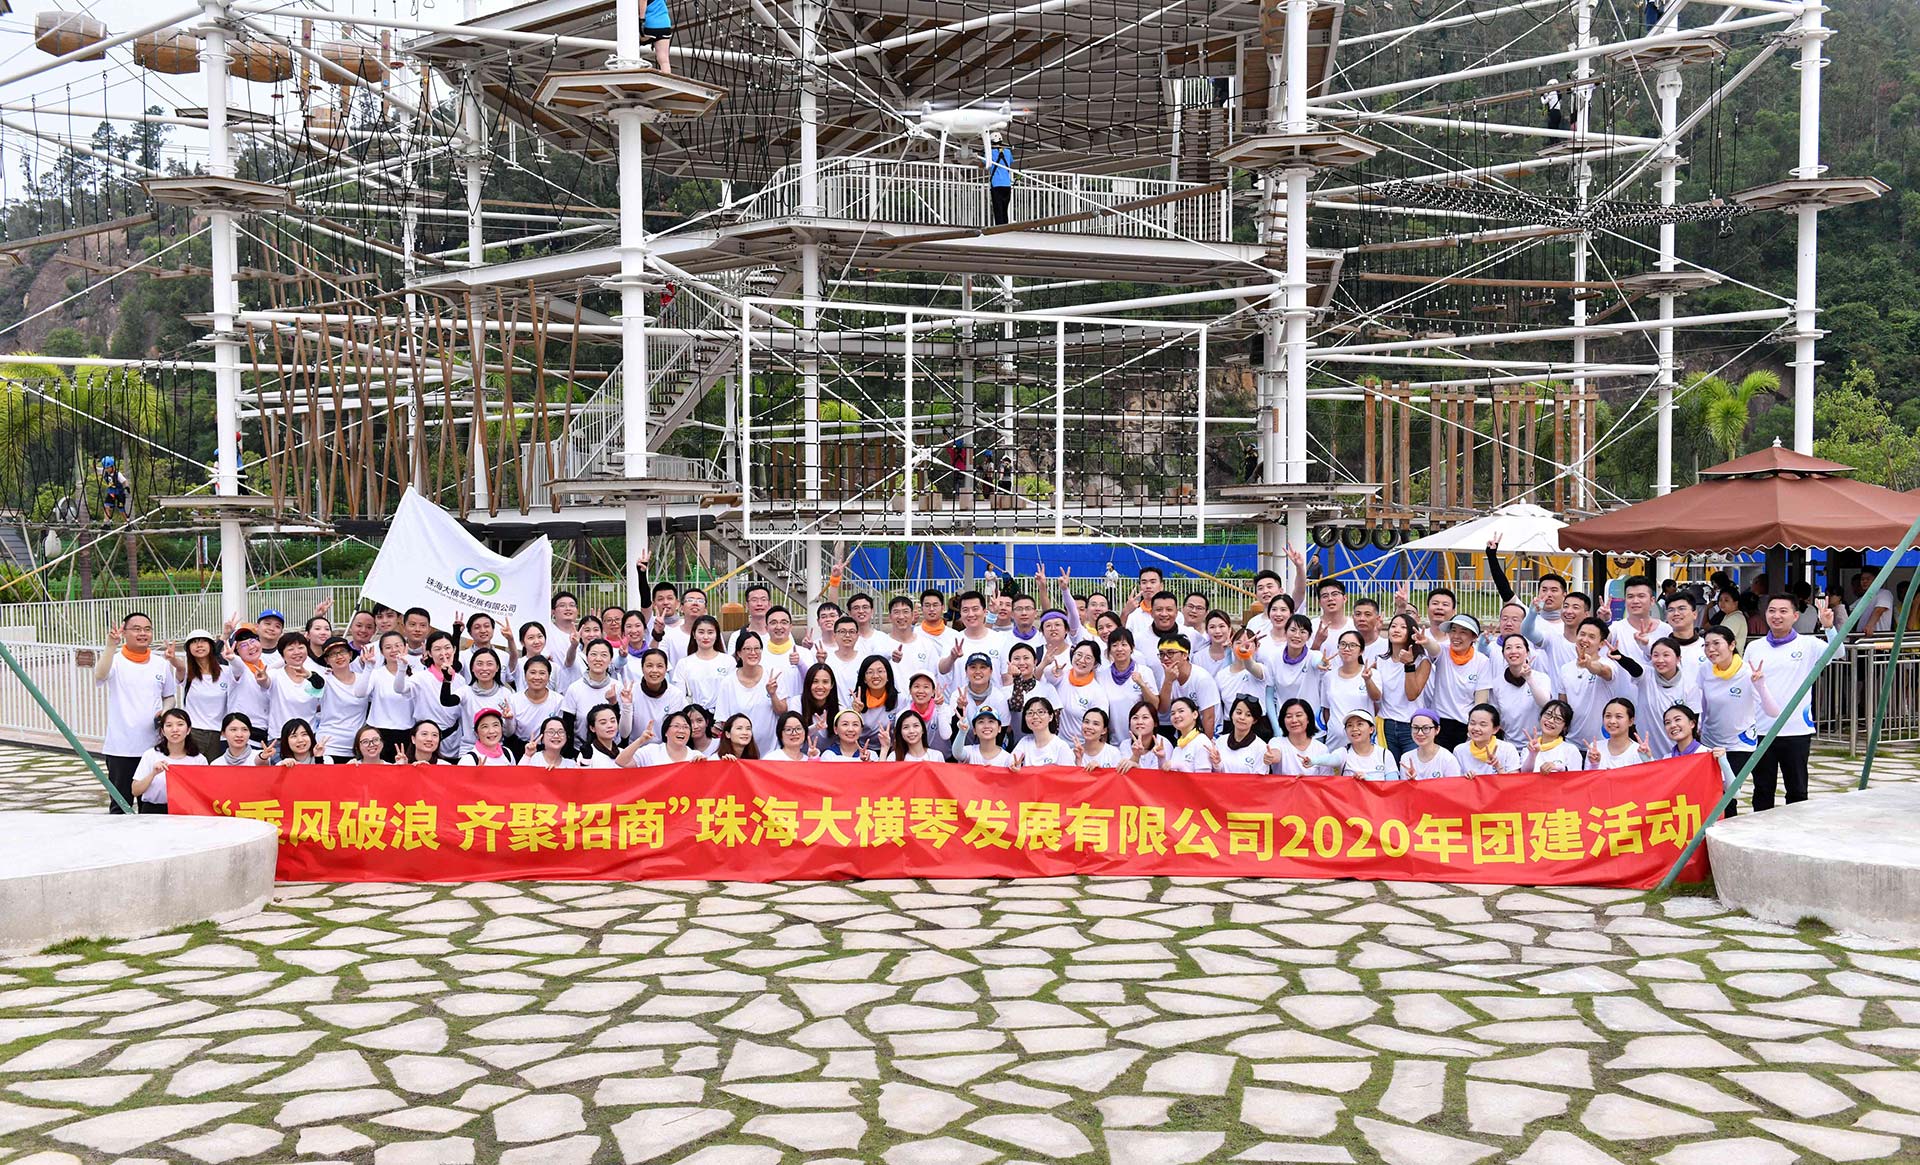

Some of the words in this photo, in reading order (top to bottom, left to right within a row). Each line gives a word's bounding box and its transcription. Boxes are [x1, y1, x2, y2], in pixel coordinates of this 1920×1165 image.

[426, 577, 517, 613] 珠海大横琴发展有限公司
